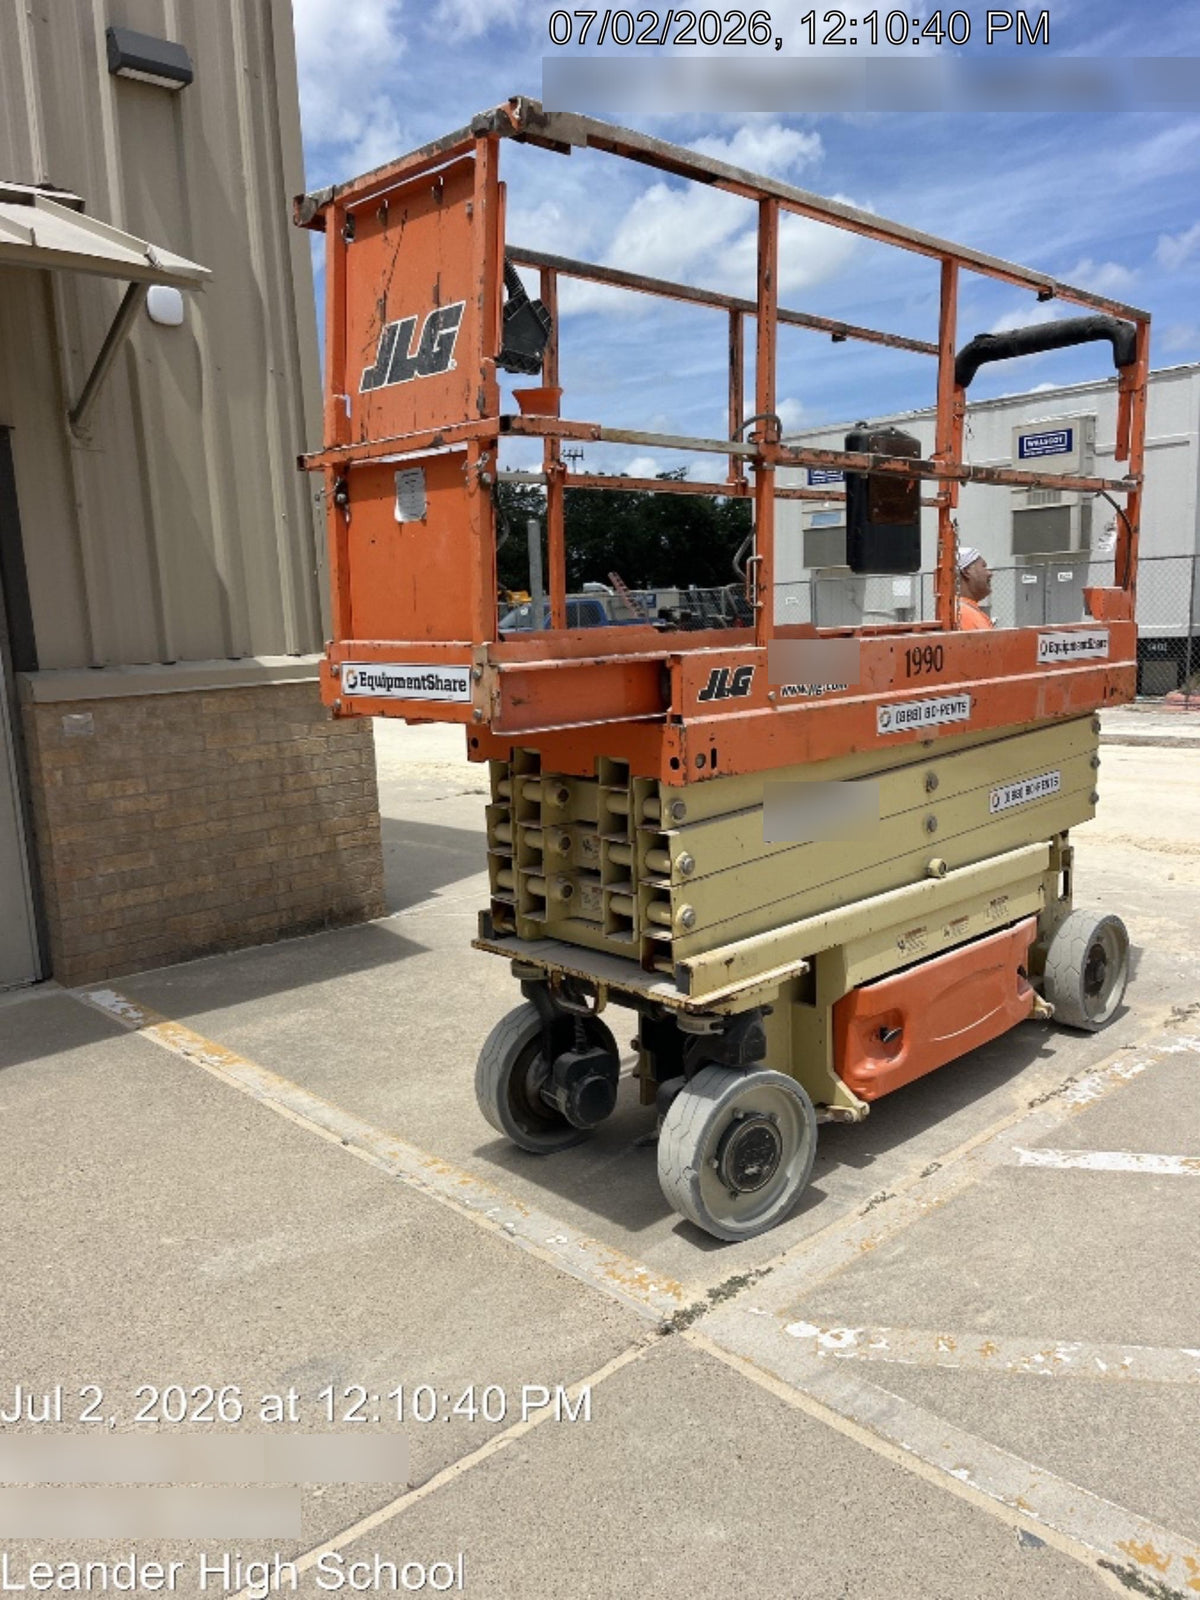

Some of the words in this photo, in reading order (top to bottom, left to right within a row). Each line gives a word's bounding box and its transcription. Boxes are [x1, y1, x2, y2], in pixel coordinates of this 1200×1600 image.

[359, 300, 466, 393] JLG
[905, 644, 944, 678] 1990
[359, 671, 467, 692] EquipmentShare
[697, 665, 756, 702] JLG
